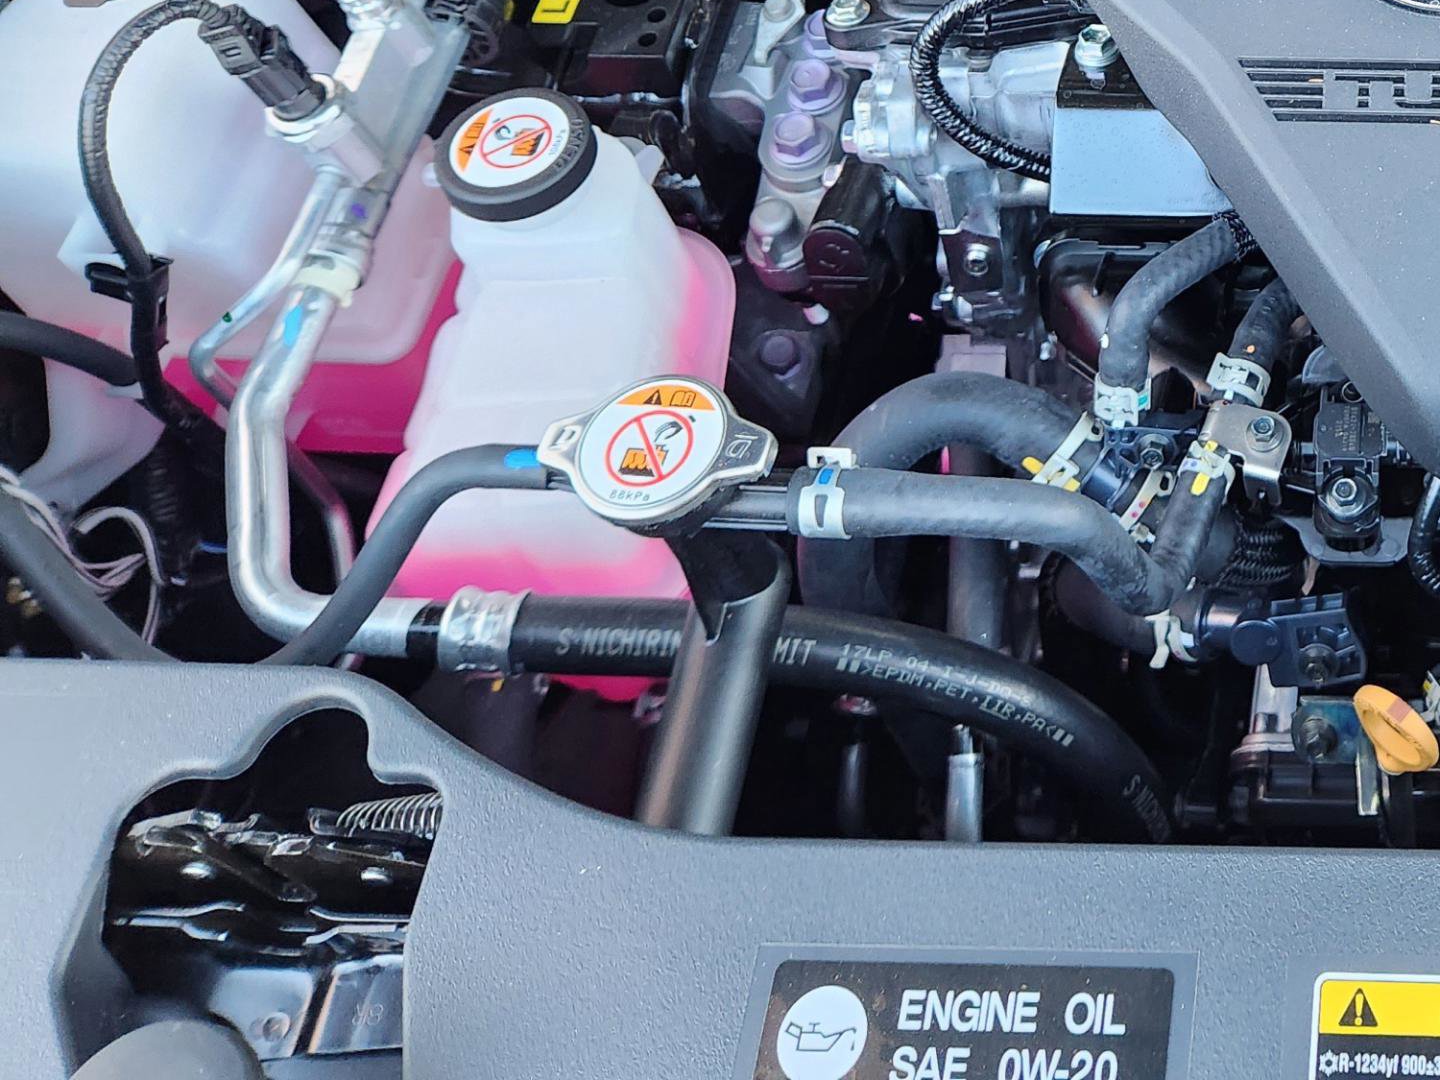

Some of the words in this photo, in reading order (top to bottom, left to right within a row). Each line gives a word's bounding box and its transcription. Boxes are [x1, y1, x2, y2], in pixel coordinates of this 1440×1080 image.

[896, 989, 1041, 1033] ENGINE
[1064, 991, 1127, 1036] OIL
[888, 1045, 971, 1080] SAE
[998, 1047, 1119, 1080] 0W-20
[1339, 1052, 1399, 1078] R-1234yf
